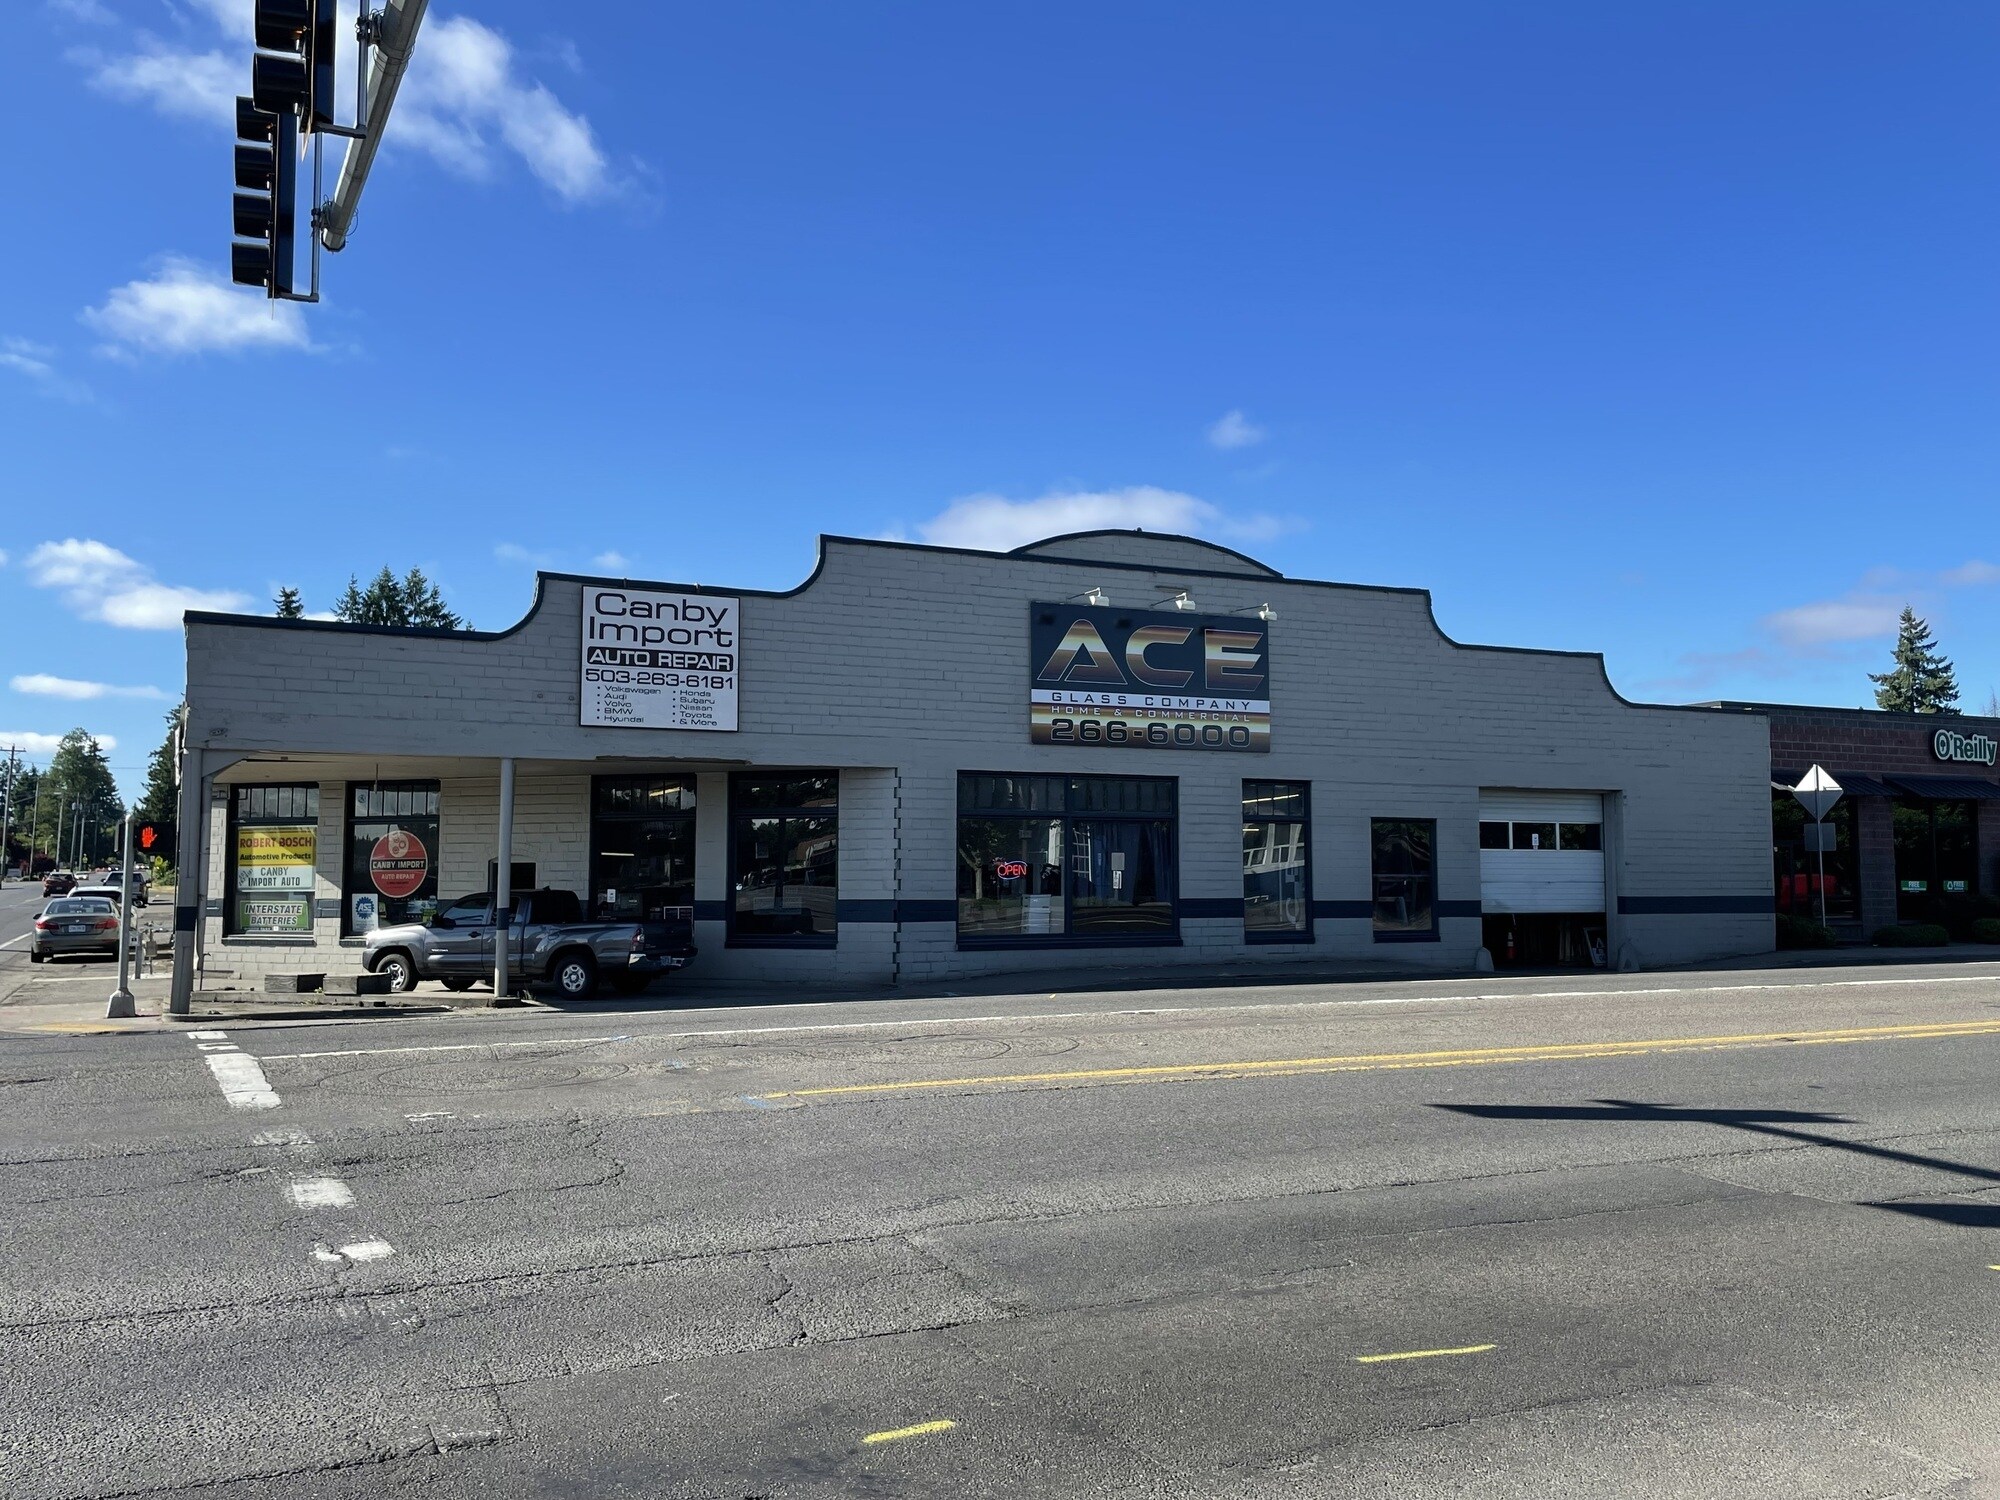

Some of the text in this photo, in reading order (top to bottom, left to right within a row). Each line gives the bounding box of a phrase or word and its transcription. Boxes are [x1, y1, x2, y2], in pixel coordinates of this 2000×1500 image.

[595, 592, 728, 628] Canby
[589, 616, 733, 648] Import
[589, 649, 731, 670] AUTO REPAIR
[1037, 619, 1264, 692] ACE
[585, 668, 733, 689] 503-263-6181
[604, 685, 661, 695] Volkswagen
[604, 692, 627, 700] Audi
[680, 696, 715, 704] Subaru
[1052, 692, 1250, 710] GLASS COMPANY
[604, 707, 633, 715] BMW
[680, 711, 712, 719] Toyota
[1052, 706, 1250, 722] HOME & COMMERCIAL
[604, 715, 644, 723] Hyundai
[1051, 718, 1251, 748] 266-6000
[1935, 730, 1997, 764] O'Reilly
[240, 837, 312, 848] ROBERT BOSCH
[281, 852, 311, 860] Products
[260, 867, 288, 876] CANBY
[998, 865, 1026, 876] OPEN
[248, 877, 277, 886] IMPORT
[281, 877, 301, 886] AUTO
[245, 904, 303, 914] INTERSTATE
[358, 903, 372, 912] ASE
[251, 916, 297, 924] BATTERIES
